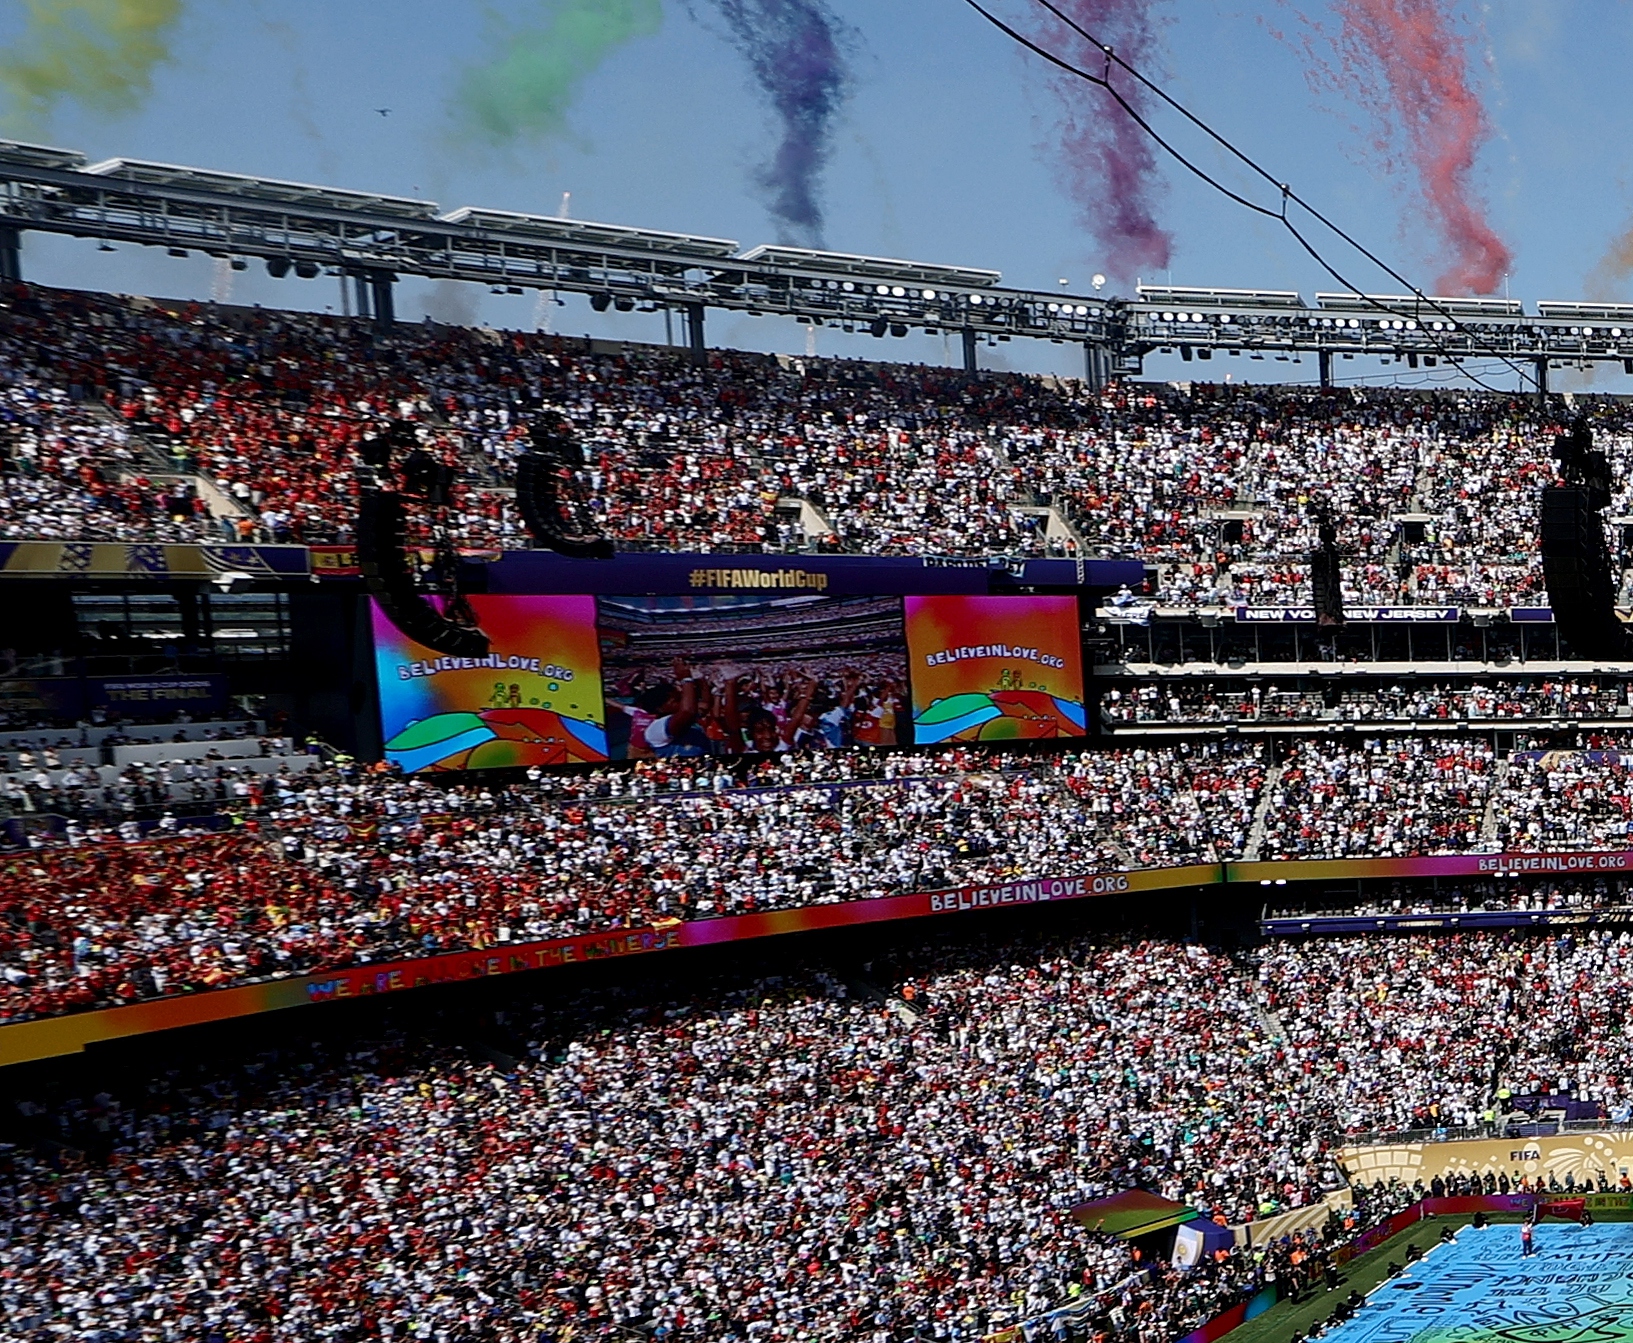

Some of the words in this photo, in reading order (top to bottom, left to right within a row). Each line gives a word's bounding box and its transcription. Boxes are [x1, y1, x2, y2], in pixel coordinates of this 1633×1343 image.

[689, 569, 828, 591] #FIFAWorldCup
[1245, 609, 1285, 621] NEW
[1286, 609, 1316, 621] YO
[1379, 609, 1450, 620] JERSEY
[925, 643, 1065, 669] BELIEVEINLOVE.ORG
[397, 653, 574, 682] BELIEVEINLOVE.ORG
[1478, 855, 1626, 872] BELIEVEINLOVE.ORG
[931, 875, 1129, 912] BELIEVEINLOVE.ORG
[1510, 1150, 1541, 1161] FIFA
